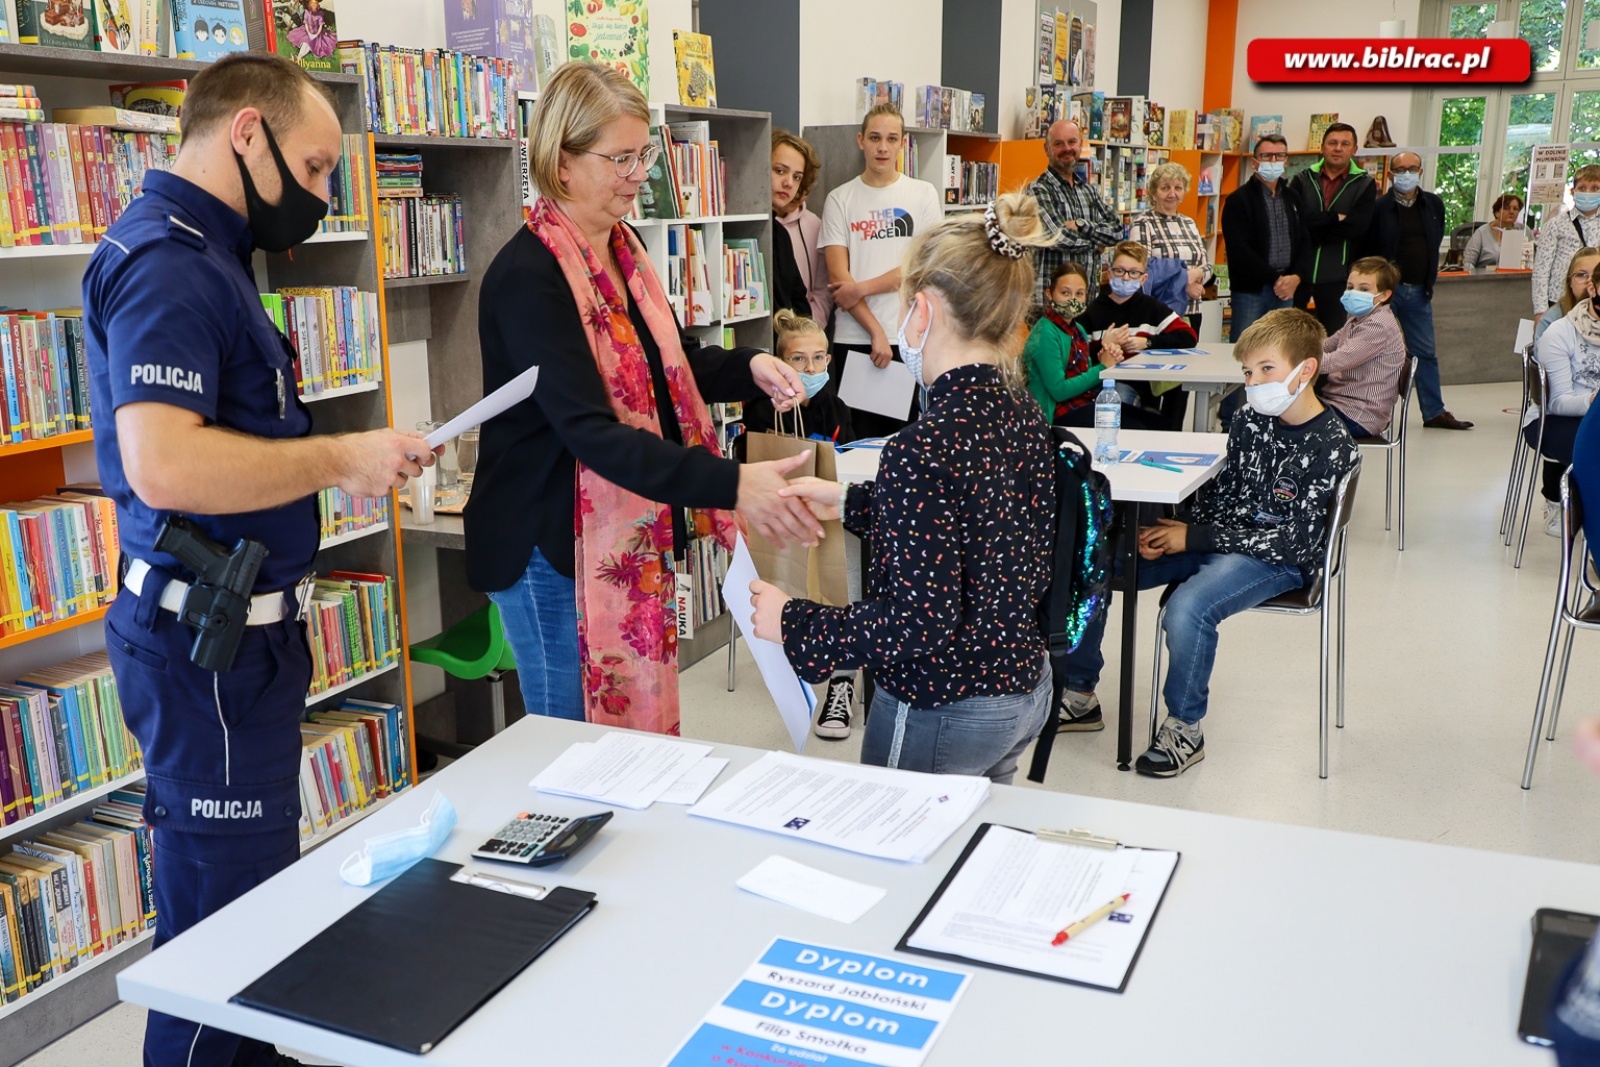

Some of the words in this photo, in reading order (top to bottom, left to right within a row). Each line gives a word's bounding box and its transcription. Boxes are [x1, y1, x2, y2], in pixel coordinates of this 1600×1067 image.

[851, 219, 893, 232] NORTH
[869, 208, 892, 220] THE
[864, 228, 894, 240] FACE
[131, 364, 204, 394] POLICJA
[678, 596, 688, 636] NAUKA
[191, 798, 263, 819] POLICJA
[795, 948, 929, 989] Dyplom
[767, 970, 836, 993] Ryszard
[838, 985, 928, 1011] Jabłoński
[760, 990, 900, 1035] Dyplom
[755, 1020, 791, 1037] Filip
